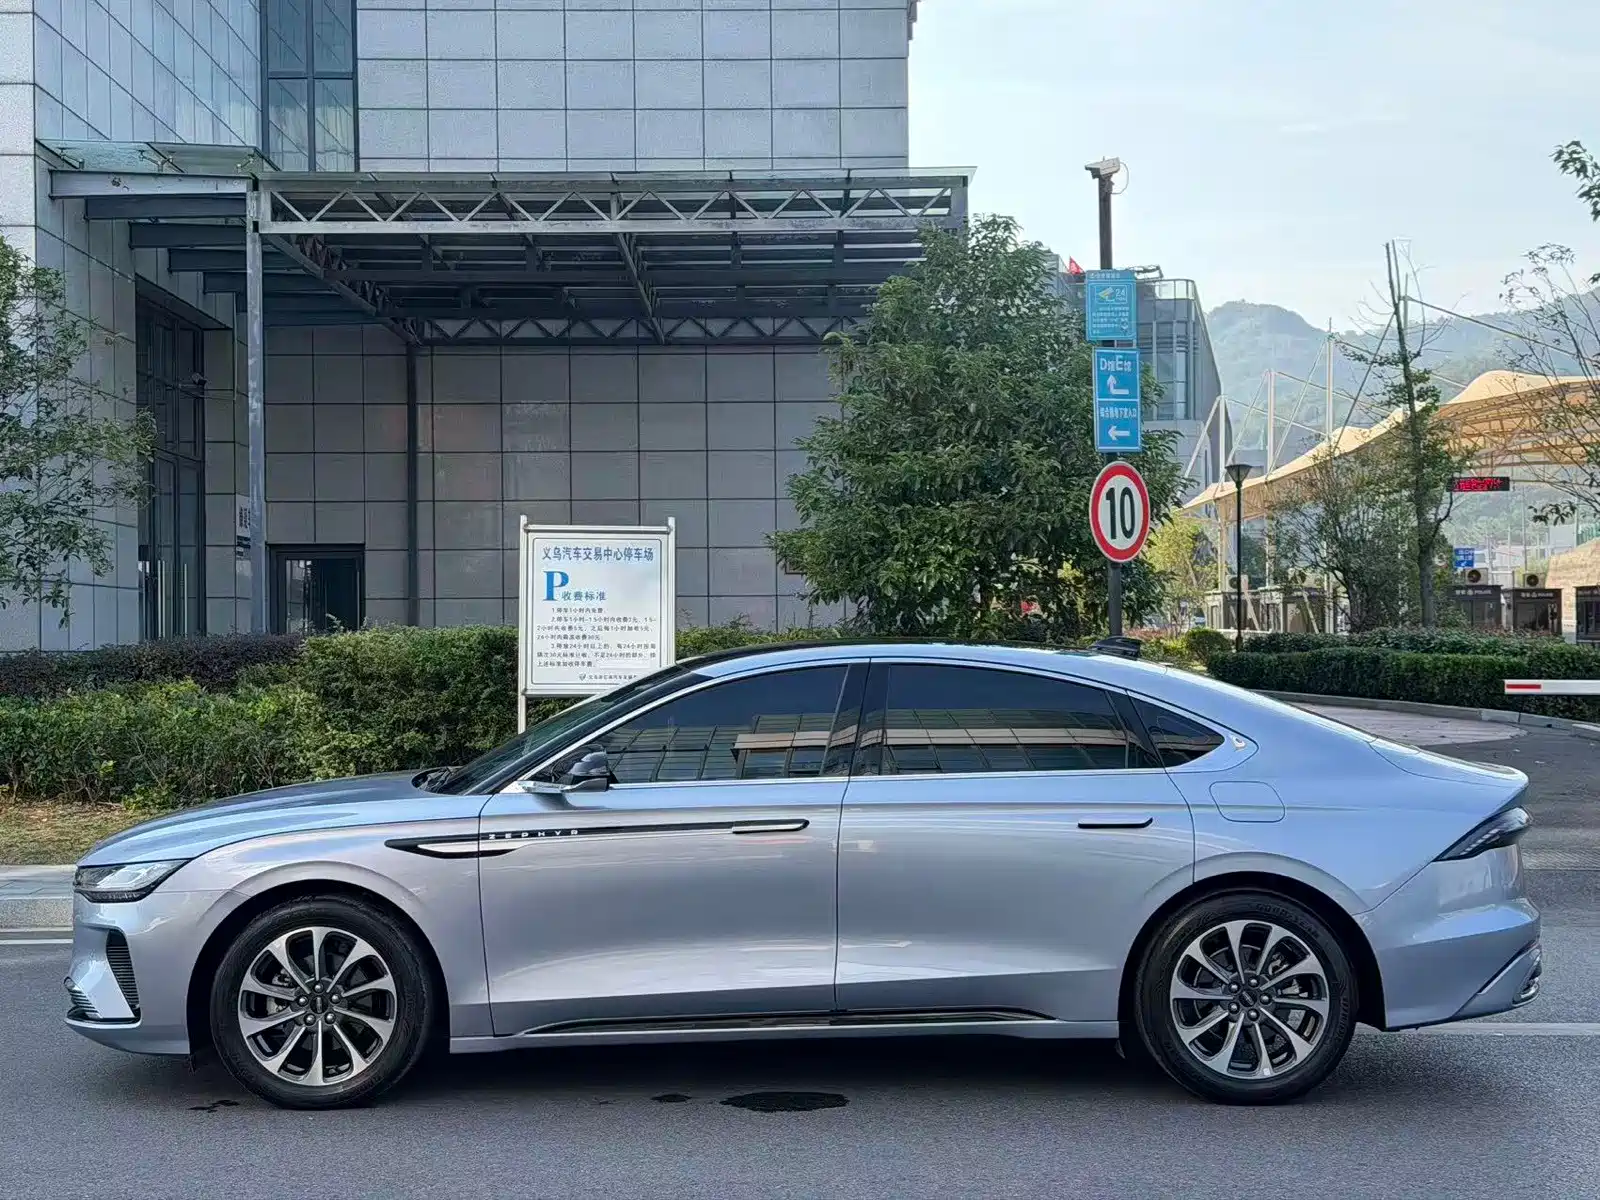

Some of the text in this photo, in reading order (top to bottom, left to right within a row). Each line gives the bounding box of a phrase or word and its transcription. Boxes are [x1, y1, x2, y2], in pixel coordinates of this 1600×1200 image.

[1105, 486, 1137, 540] 10
[541, 546, 654, 562] 义乌汽车交易中心停车场
[542, 570, 607, 602] P 收费标准
[488, 829, 579, 840] ZEPHYR
